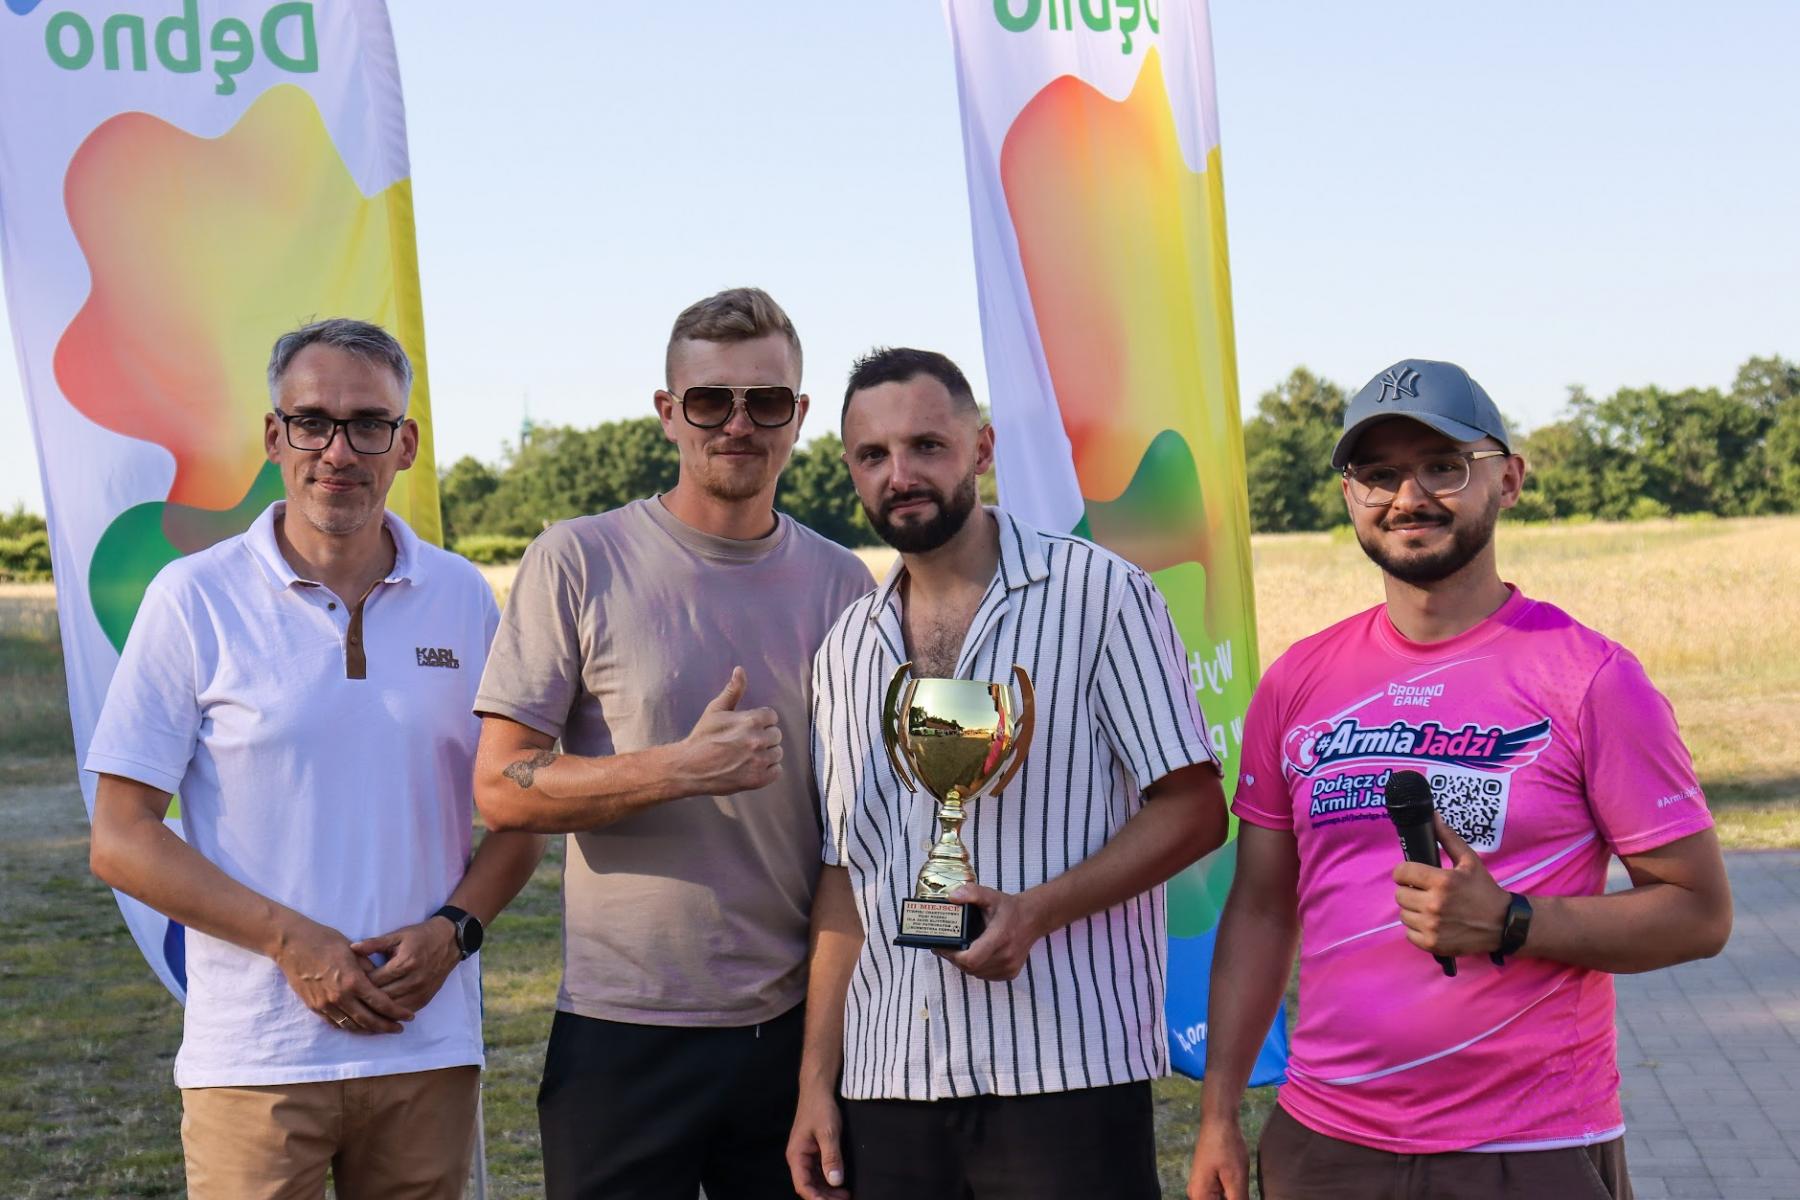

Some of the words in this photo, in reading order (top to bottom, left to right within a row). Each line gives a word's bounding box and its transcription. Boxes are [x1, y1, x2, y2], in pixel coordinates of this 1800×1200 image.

[1387, 682, 1445, 697] GROUND
[1393, 695, 1432, 708] GAME
[1311, 774, 1375, 797] Dołącz
[1377, 770, 1391, 787] d
[1310, 791, 1358, 816] Armii
[919, 903, 961, 912] MIEJSCE
